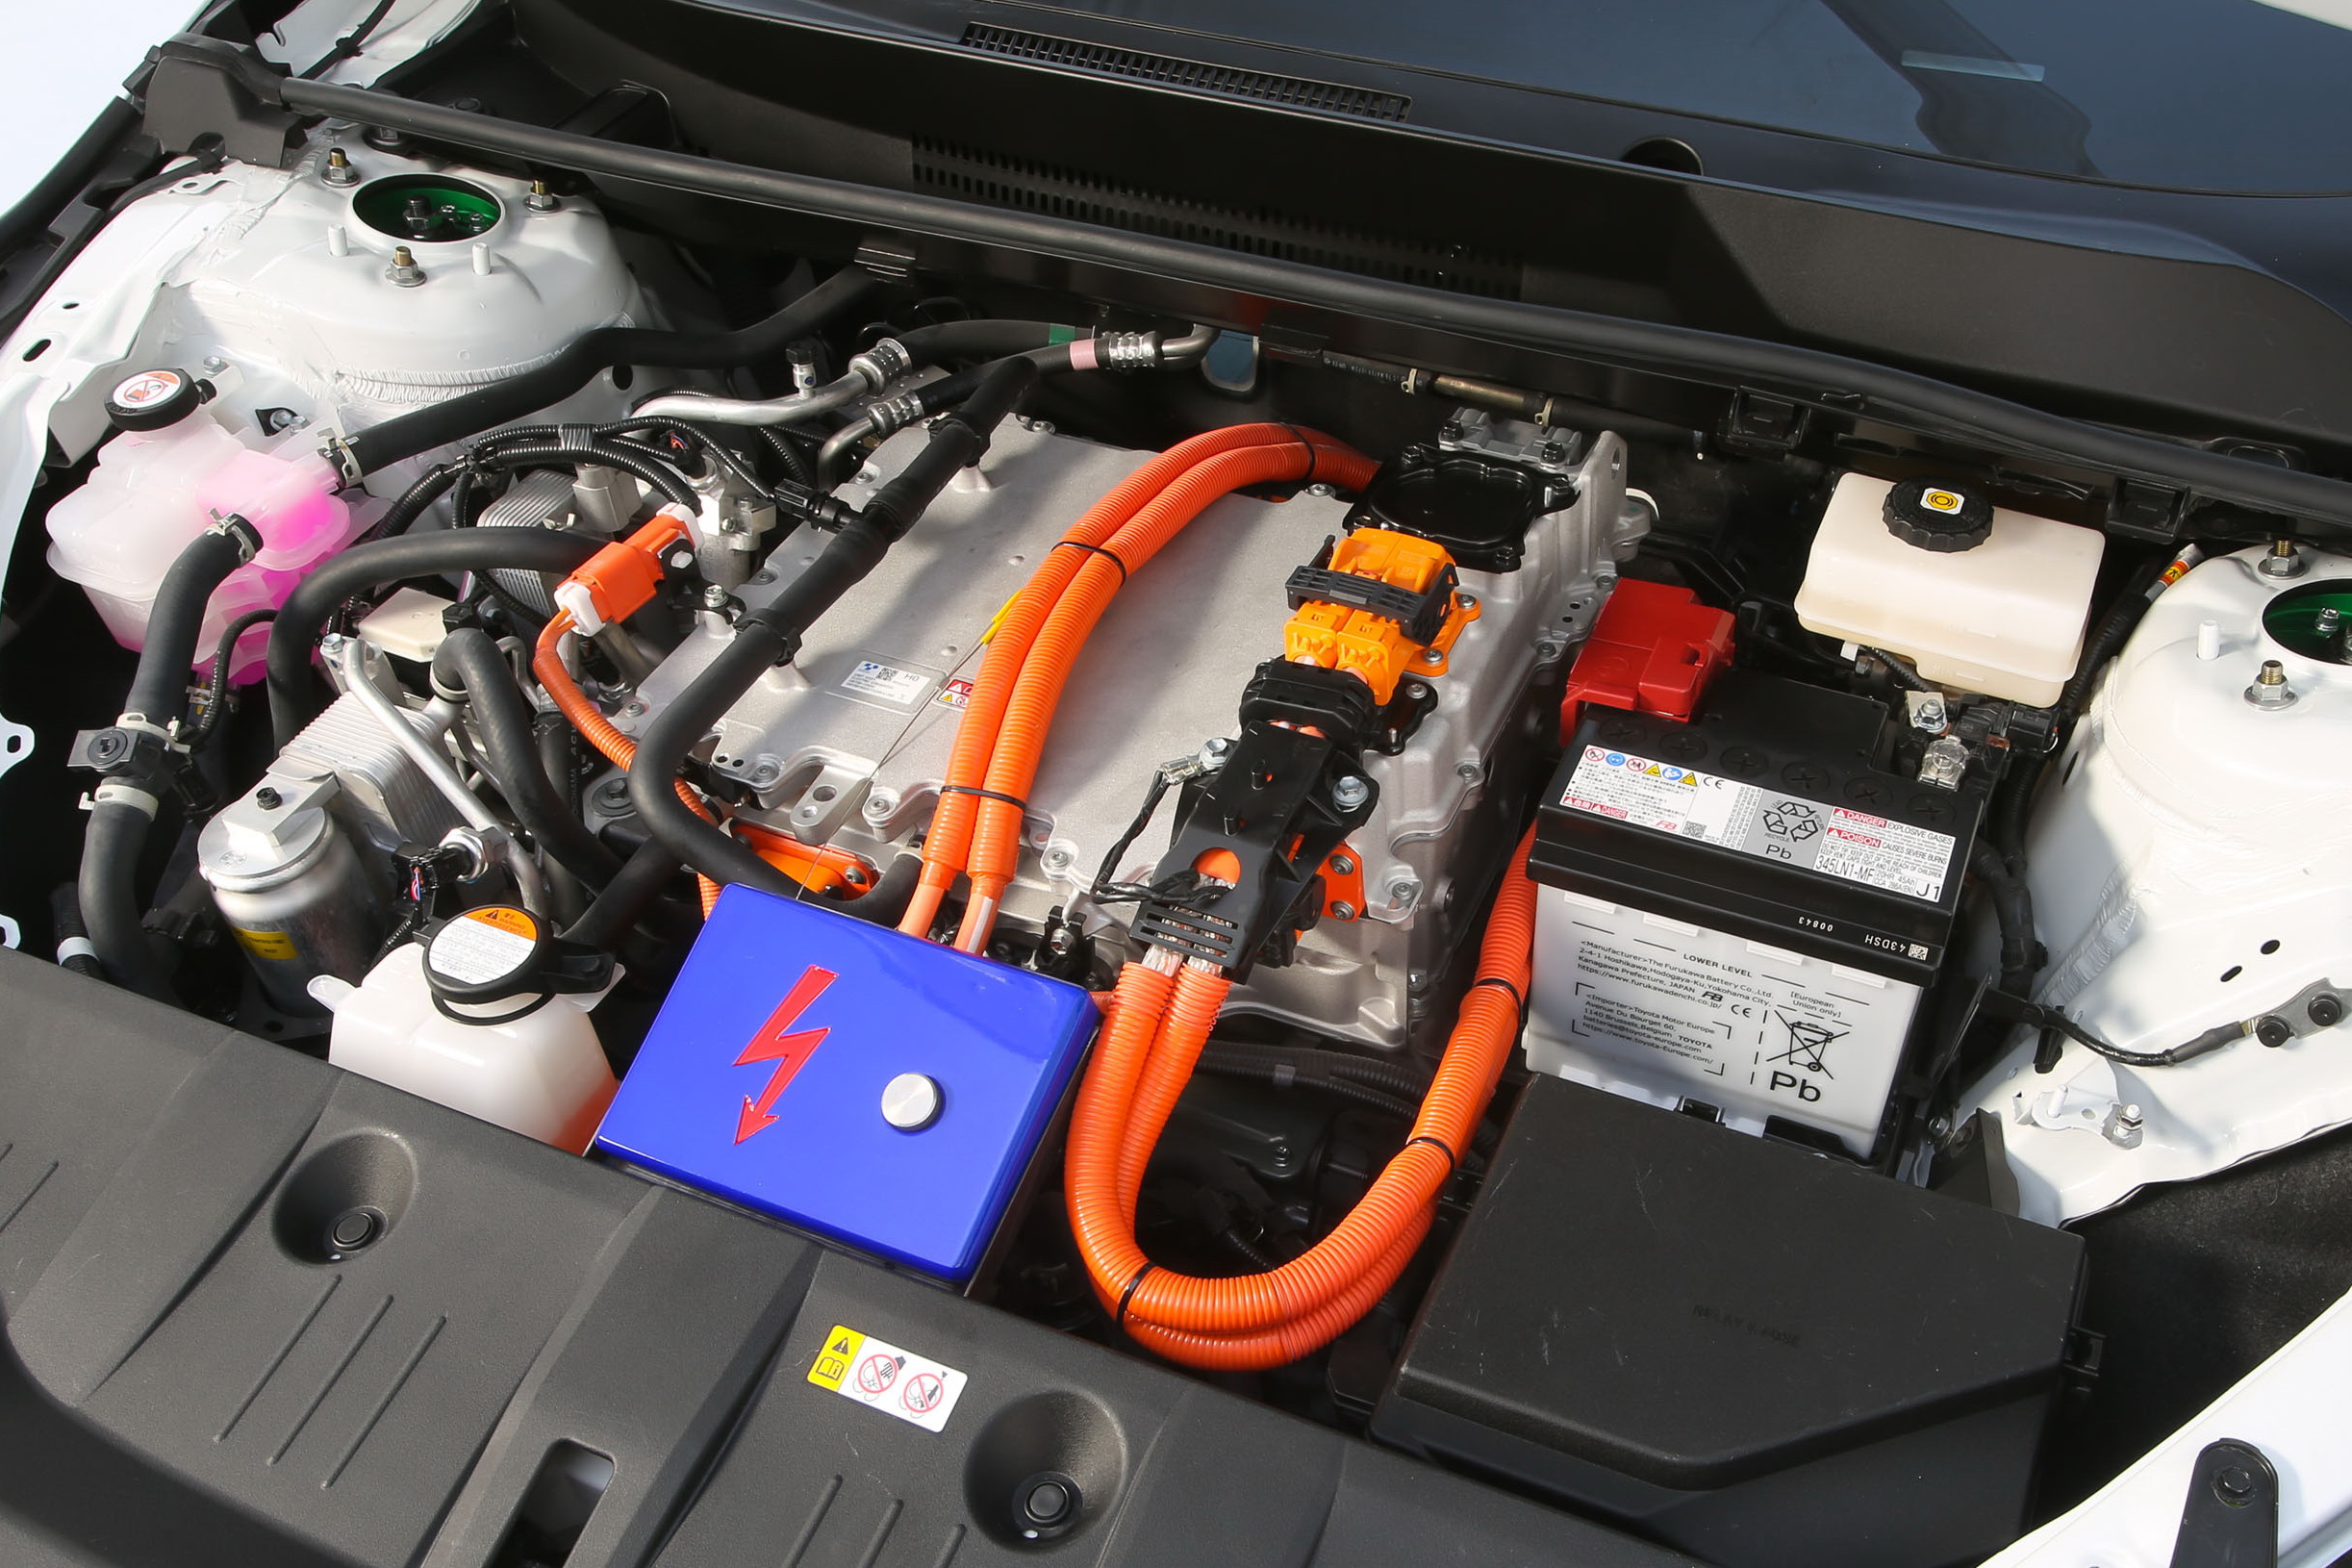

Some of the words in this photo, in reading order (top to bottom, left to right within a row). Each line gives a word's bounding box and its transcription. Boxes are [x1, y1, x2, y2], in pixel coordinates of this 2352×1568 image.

[1602, 806, 1628, 819] DANGER
[1764, 832, 1790, 843] RECYCLE
[1846, 812, 1885, 826] DANGER
[1887, 822, 1927, 838] EXPLOSIVE
[1927, 832, 1954, 845] GASES
[1765, 844, 1792, 860] Pb
[1840, 830, 1880, 847] POISON
[1882, 842, 1906, 853] CAUSES
[1905, 847, 1928, 859] SEVERE
[1927, 854, 1948, 865] BURNS
[1815, 855, 1875, 879] 345LN1-MF
[1798, 917, 1834, 932] 00843
[1864, 934, 1907, 953] 43DSH
[1577, 955, 1619, 974] Kanagawa
[1668, 980, 1695, 993] JAPAN
[1683, 952, 1720, 970] LOWER
[1722, 963, 1754, 978] LEVEL
[1579, 948, 1601, 958] 2-4-1
[1751, 996, 1772, 1007] City,
[1665, 963, 1705, 979] Furukawa
[1705, 974, 1738, 990] Battery
[1583, 1007, 1605, 1019] 1140
[1584, 1000, 1614, 1014] Avenue
[1615, 1009, 1629, 1018] Du
[1629, 1013, 1662, 1028] Bourget
[1792, 999, 1818, 1011] Union
[1661, 1014, 1685, 1026] Motor
[1686, 1022, 1715, 1035] Europe
[1678, 1035, 1712, 1050] TOYOTA
[1768, 1070, 1823, 1103] Pb
